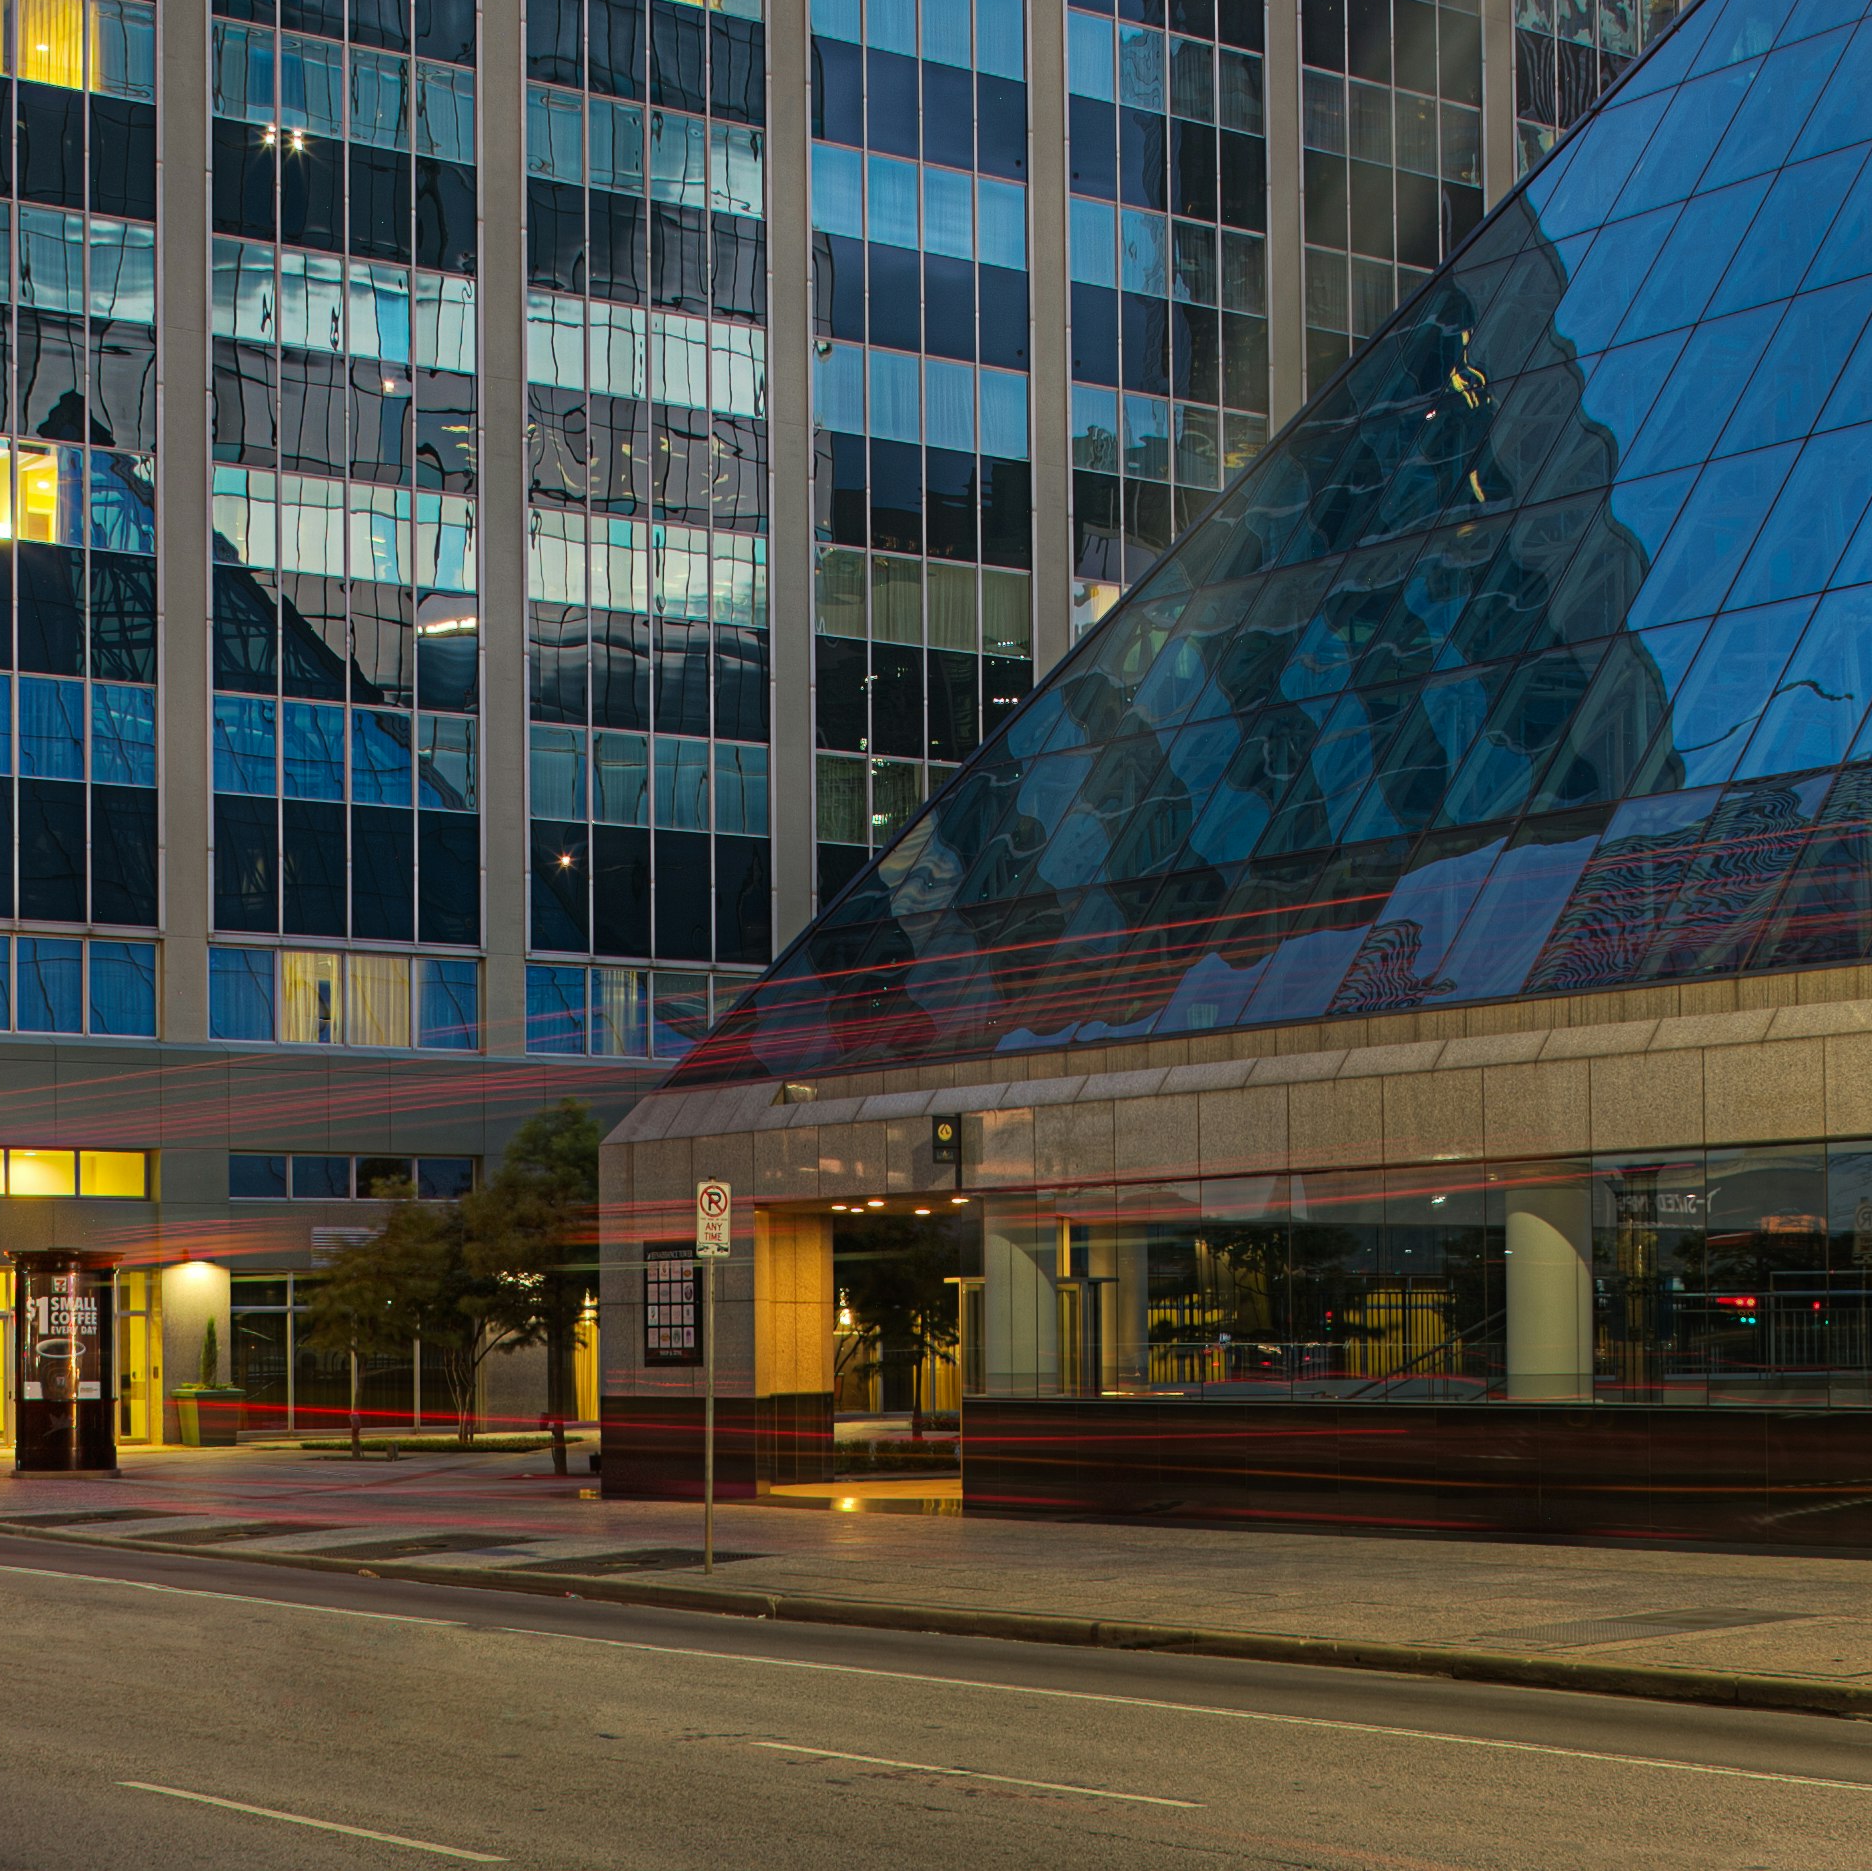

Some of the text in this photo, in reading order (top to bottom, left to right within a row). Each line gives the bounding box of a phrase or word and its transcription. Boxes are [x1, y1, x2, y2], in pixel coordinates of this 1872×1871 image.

[705, 1222, 723, 1231] ANY
[704, 1232, 723, 1241] TIME
[50, 1297, 97, 1310] SMALL
[81, 1326, 97, 1335] DAY
